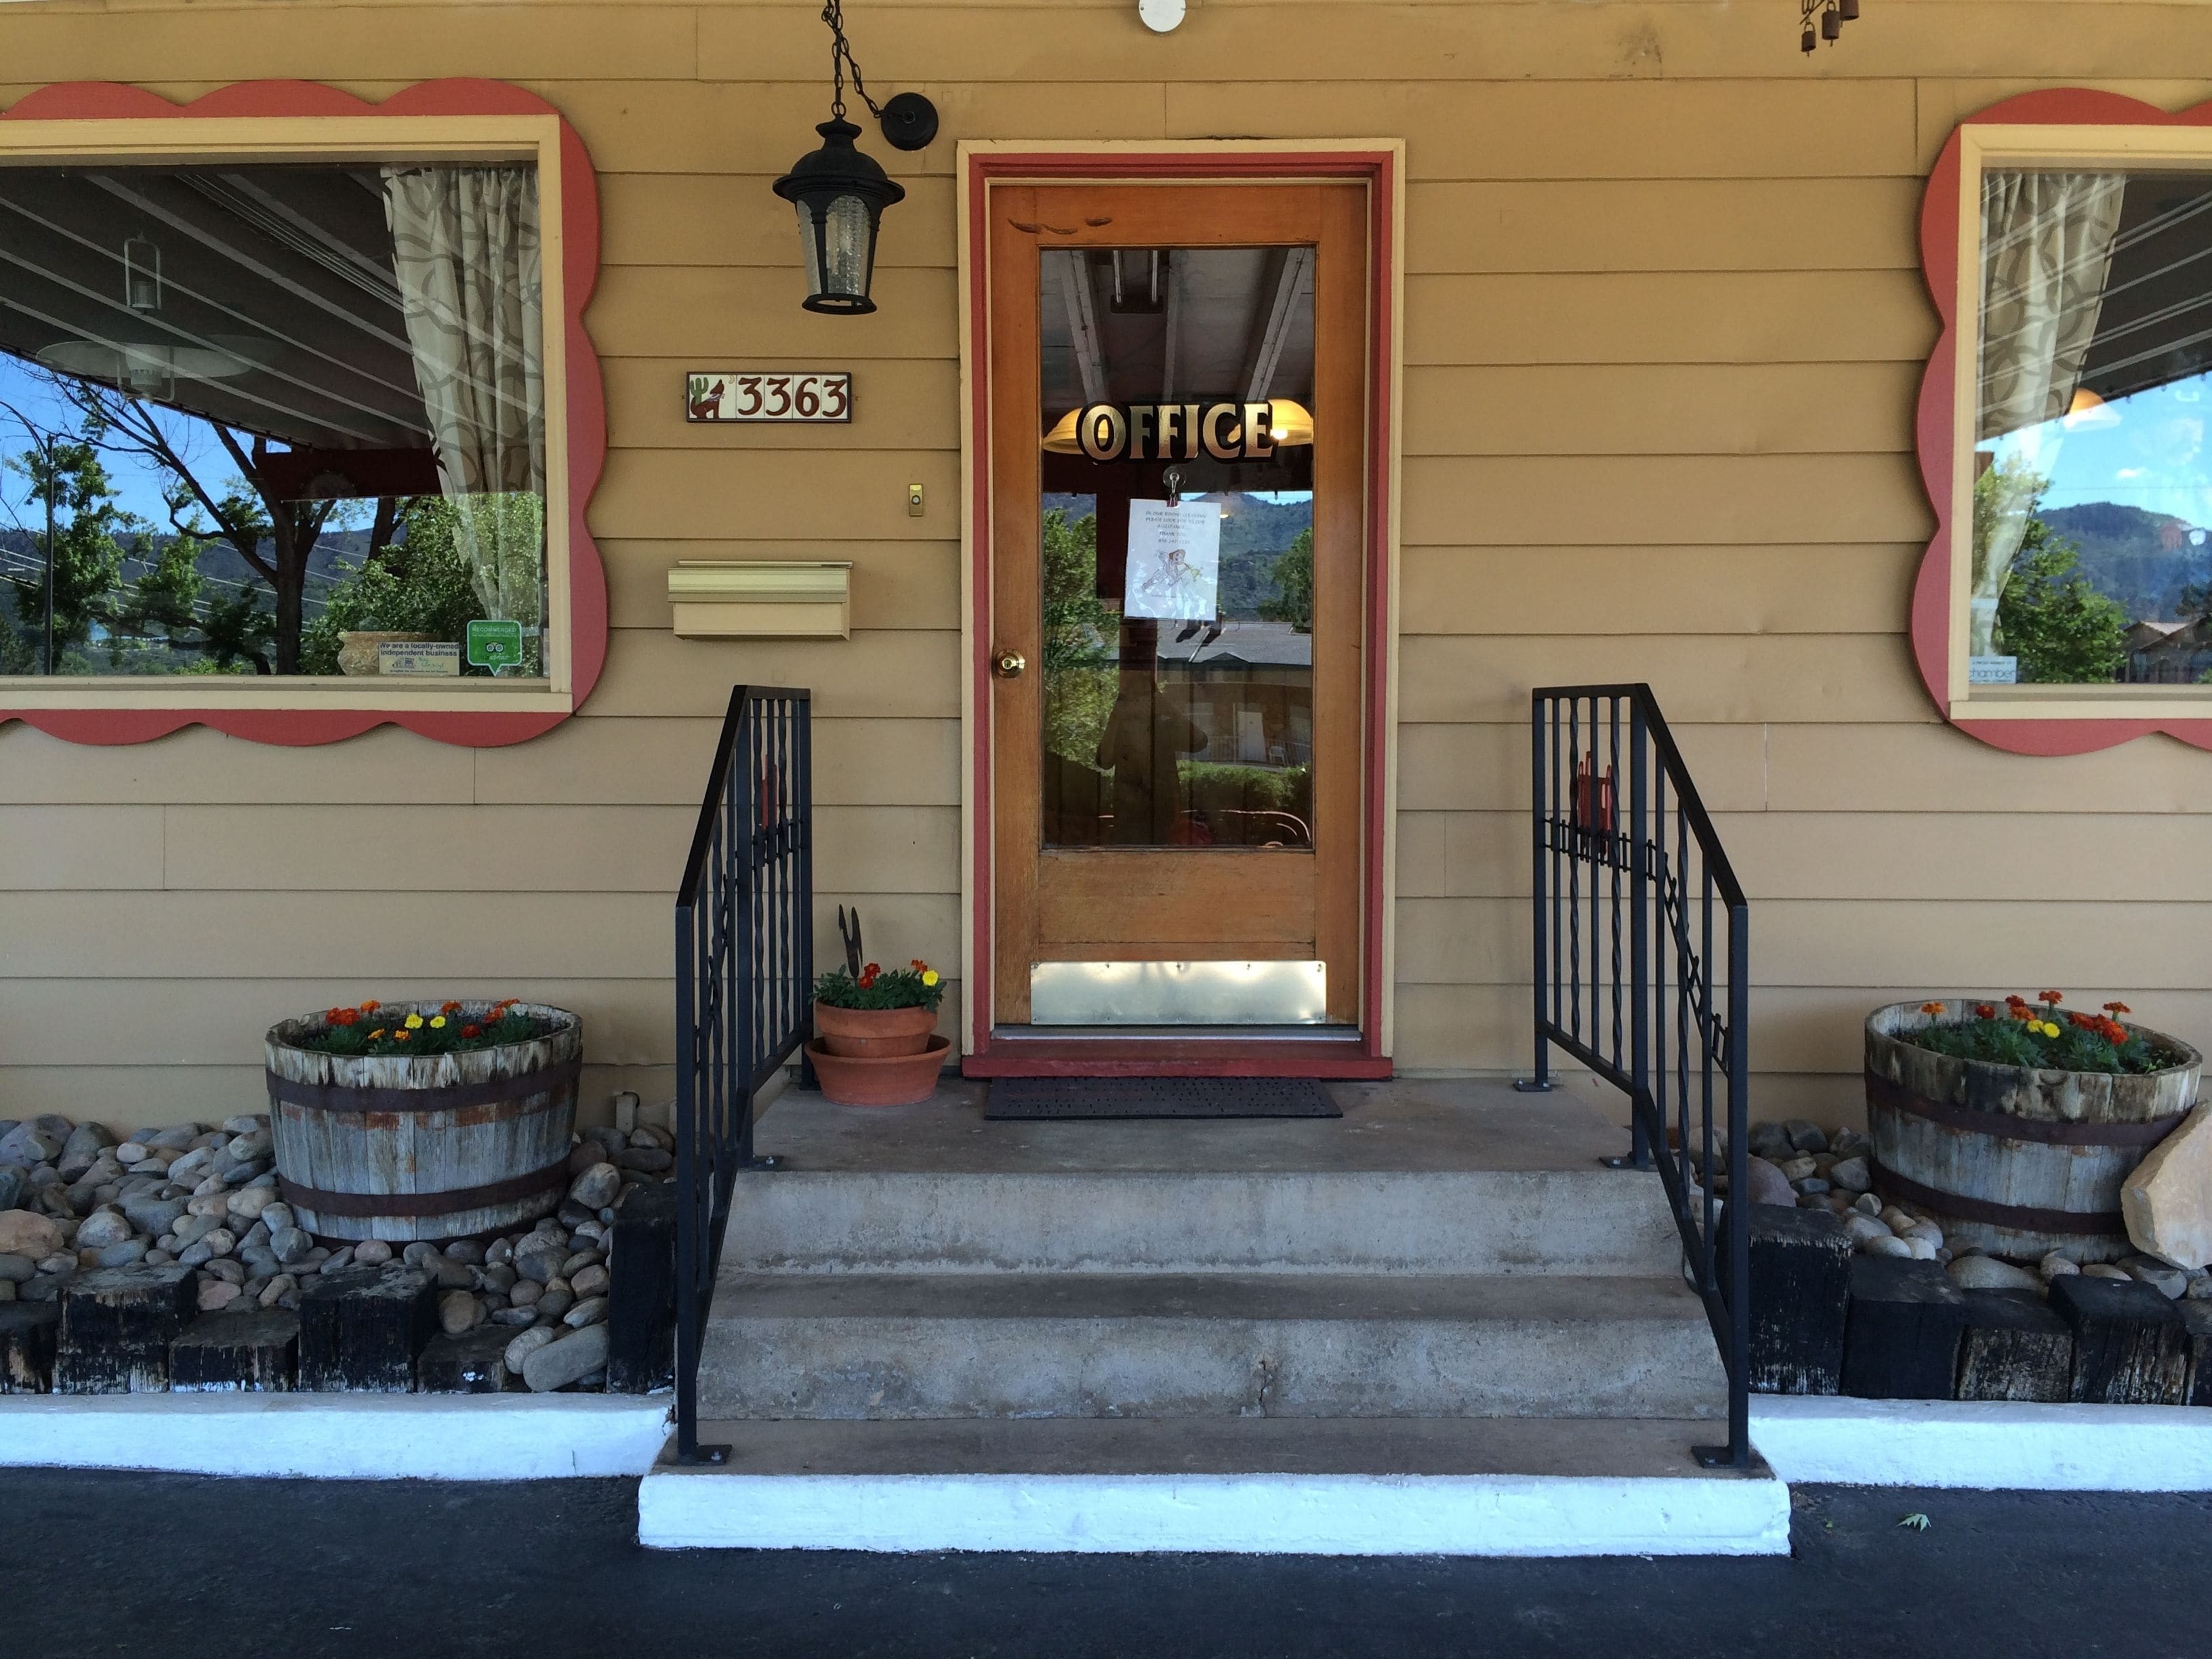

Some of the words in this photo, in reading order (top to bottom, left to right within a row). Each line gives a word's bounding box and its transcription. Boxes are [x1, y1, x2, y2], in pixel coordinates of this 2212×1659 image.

[737, 377, 847, 417] 3363
[1080, 403, 1275, 462] OFFICE
[411, 642, 459, 651] locally-owned
